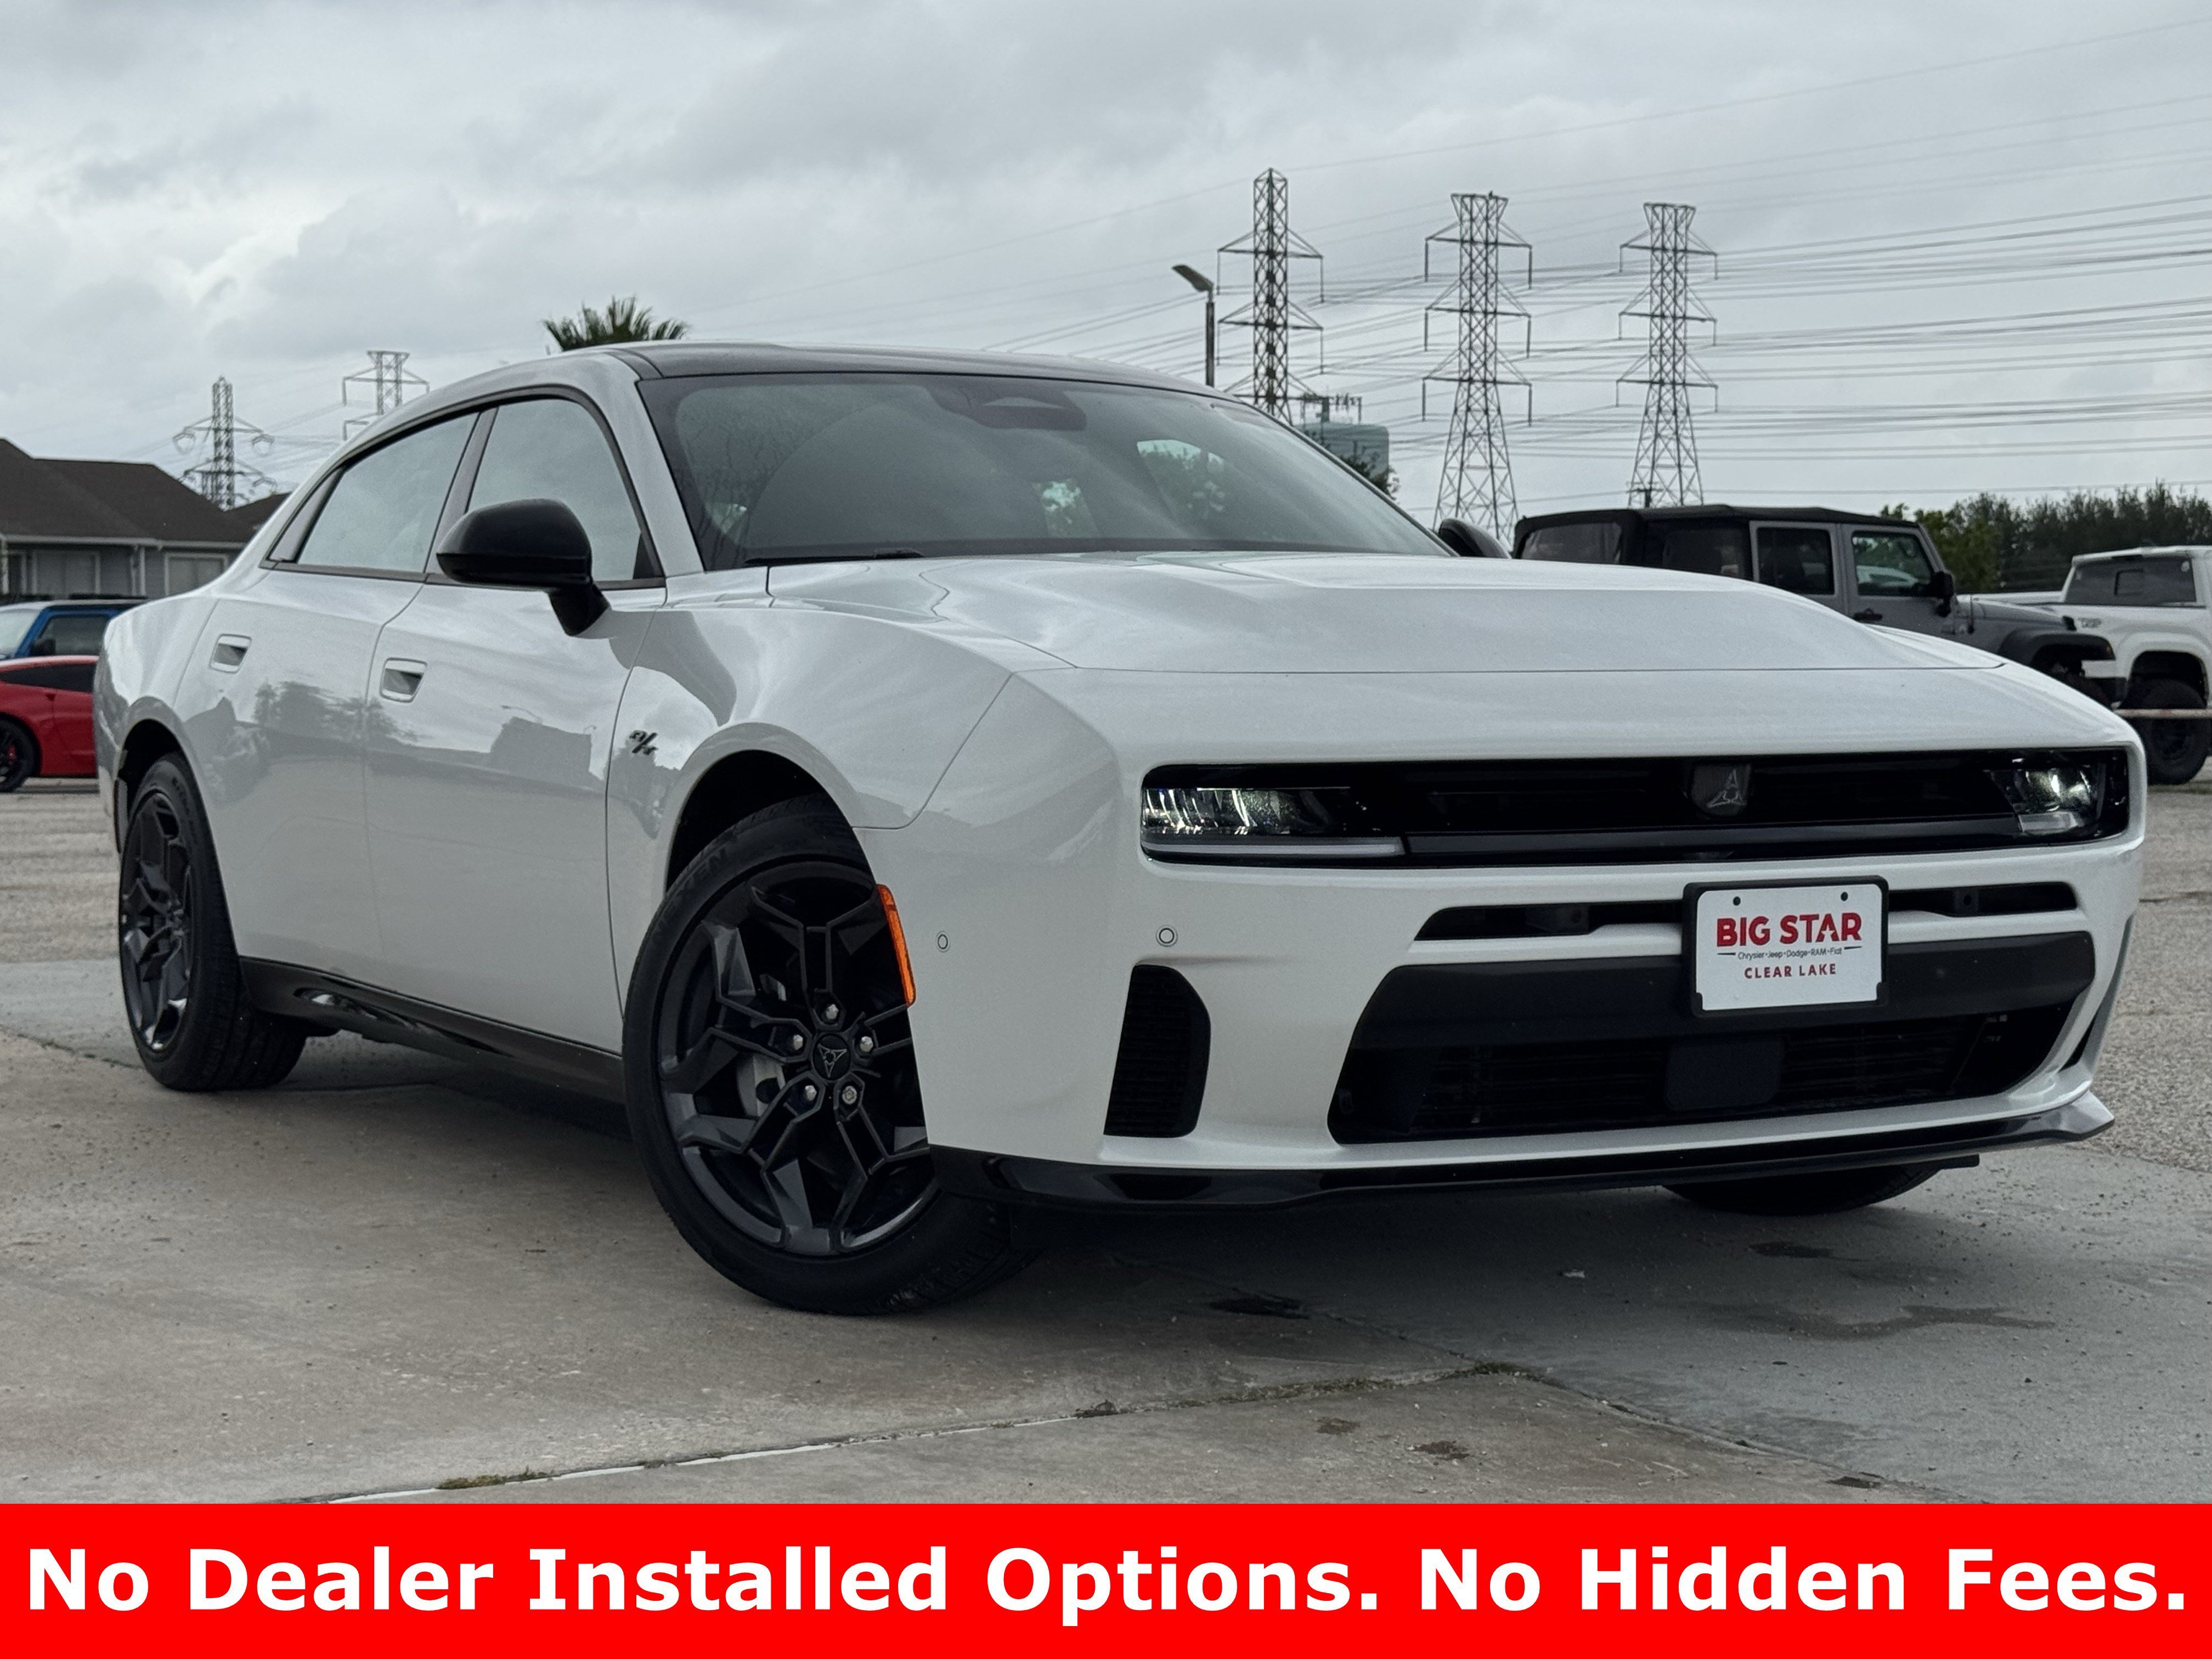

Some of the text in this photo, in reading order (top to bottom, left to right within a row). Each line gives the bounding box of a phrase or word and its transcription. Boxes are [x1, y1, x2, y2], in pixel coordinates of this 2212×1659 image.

[1717, 912, 1863, 947] BIG STAR
[1743, 963, 1837, 979] CLEAR LAKE
